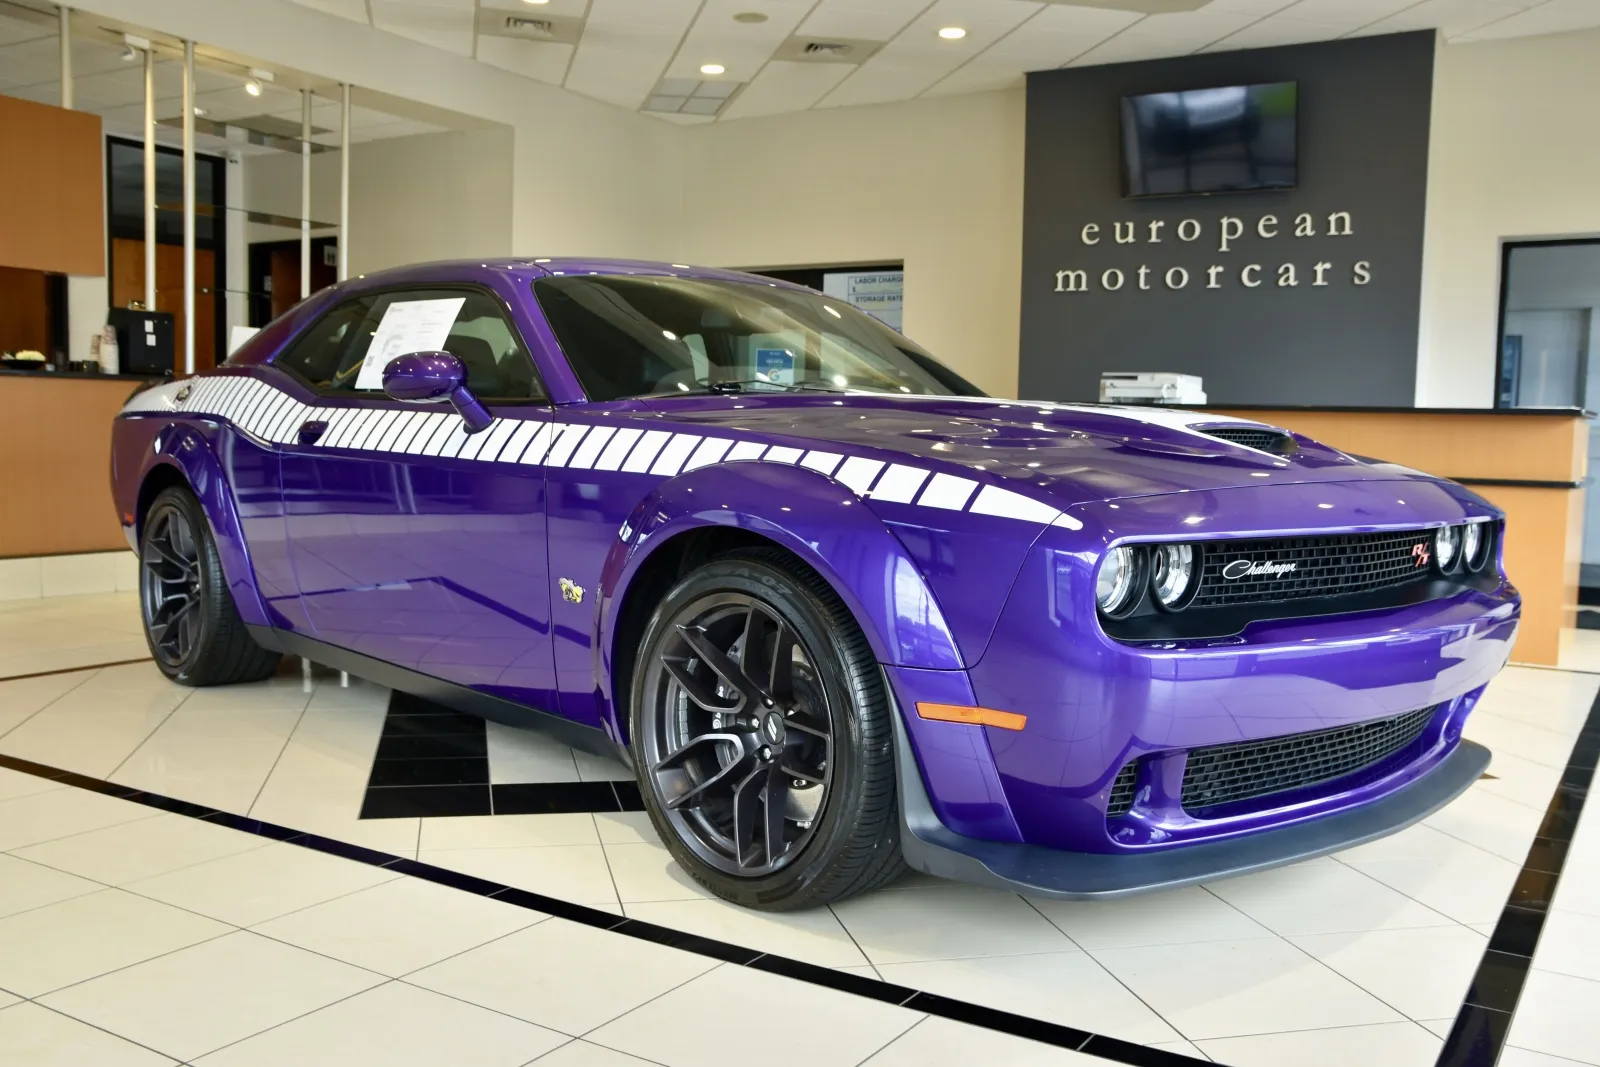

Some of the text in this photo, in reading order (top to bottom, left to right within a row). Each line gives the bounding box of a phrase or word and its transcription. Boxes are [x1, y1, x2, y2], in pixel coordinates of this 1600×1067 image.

[1081, 210, 1353, 252] european
[854, 276, 877, 285] LABOR
[1053, 260, 1371, 292] motorcars
[855, 295, 885, 303] STORAGE
[1222, 560, 1296, 579] Challenger
